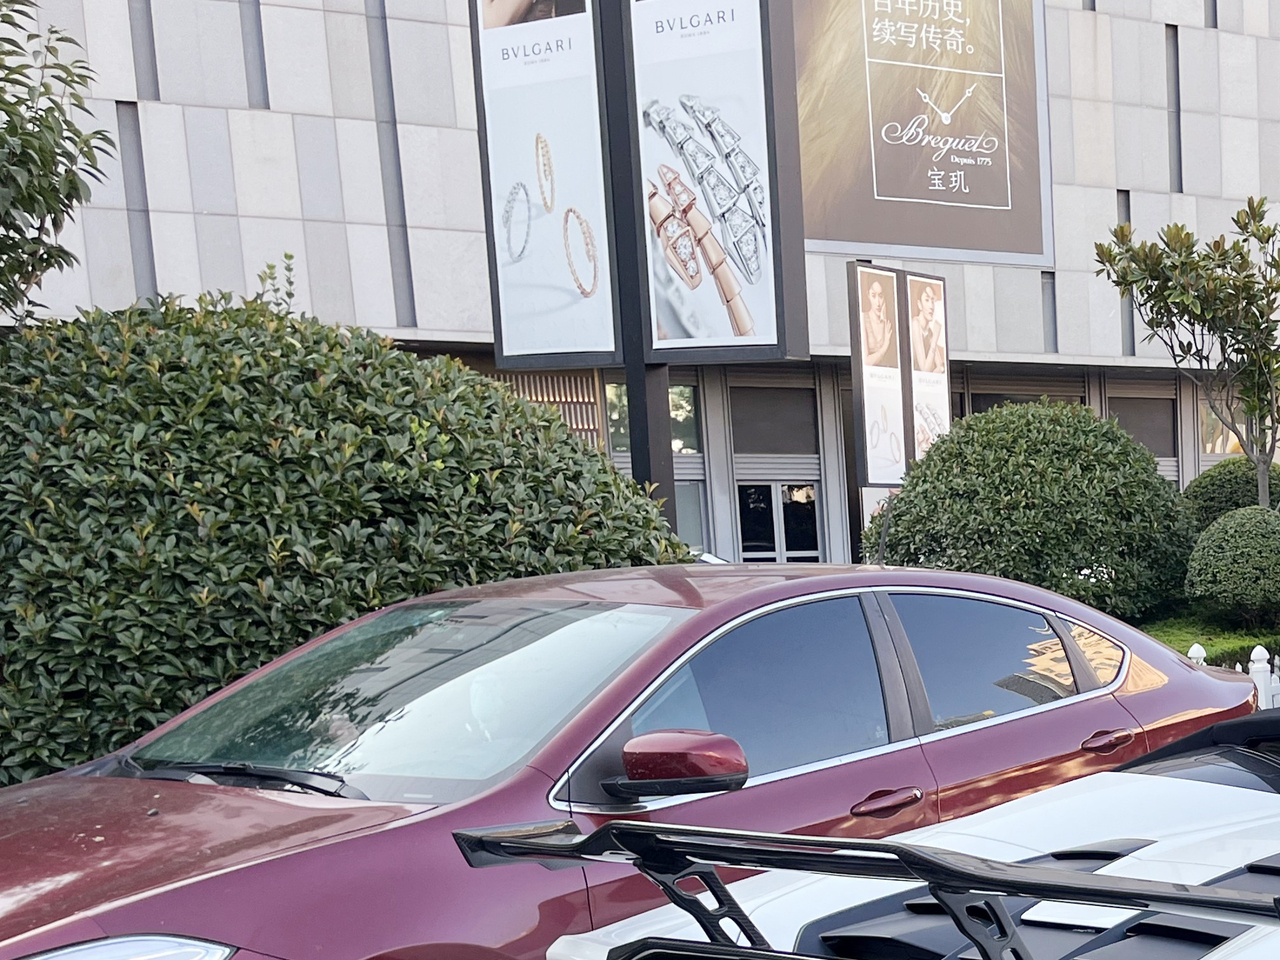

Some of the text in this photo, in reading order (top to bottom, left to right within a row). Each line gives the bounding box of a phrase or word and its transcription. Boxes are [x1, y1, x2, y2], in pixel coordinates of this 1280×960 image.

[655, 9, 736, 34] BVLGARI
[872, 17, 975, 55] 续写传奇。
[501, 38, 573, 61] BVLGARI
[881, 115, 999, 162] Breguet
[951, 155, 993, 166] Depuis 1775
[927, 166, 970, 193] 宝玑
